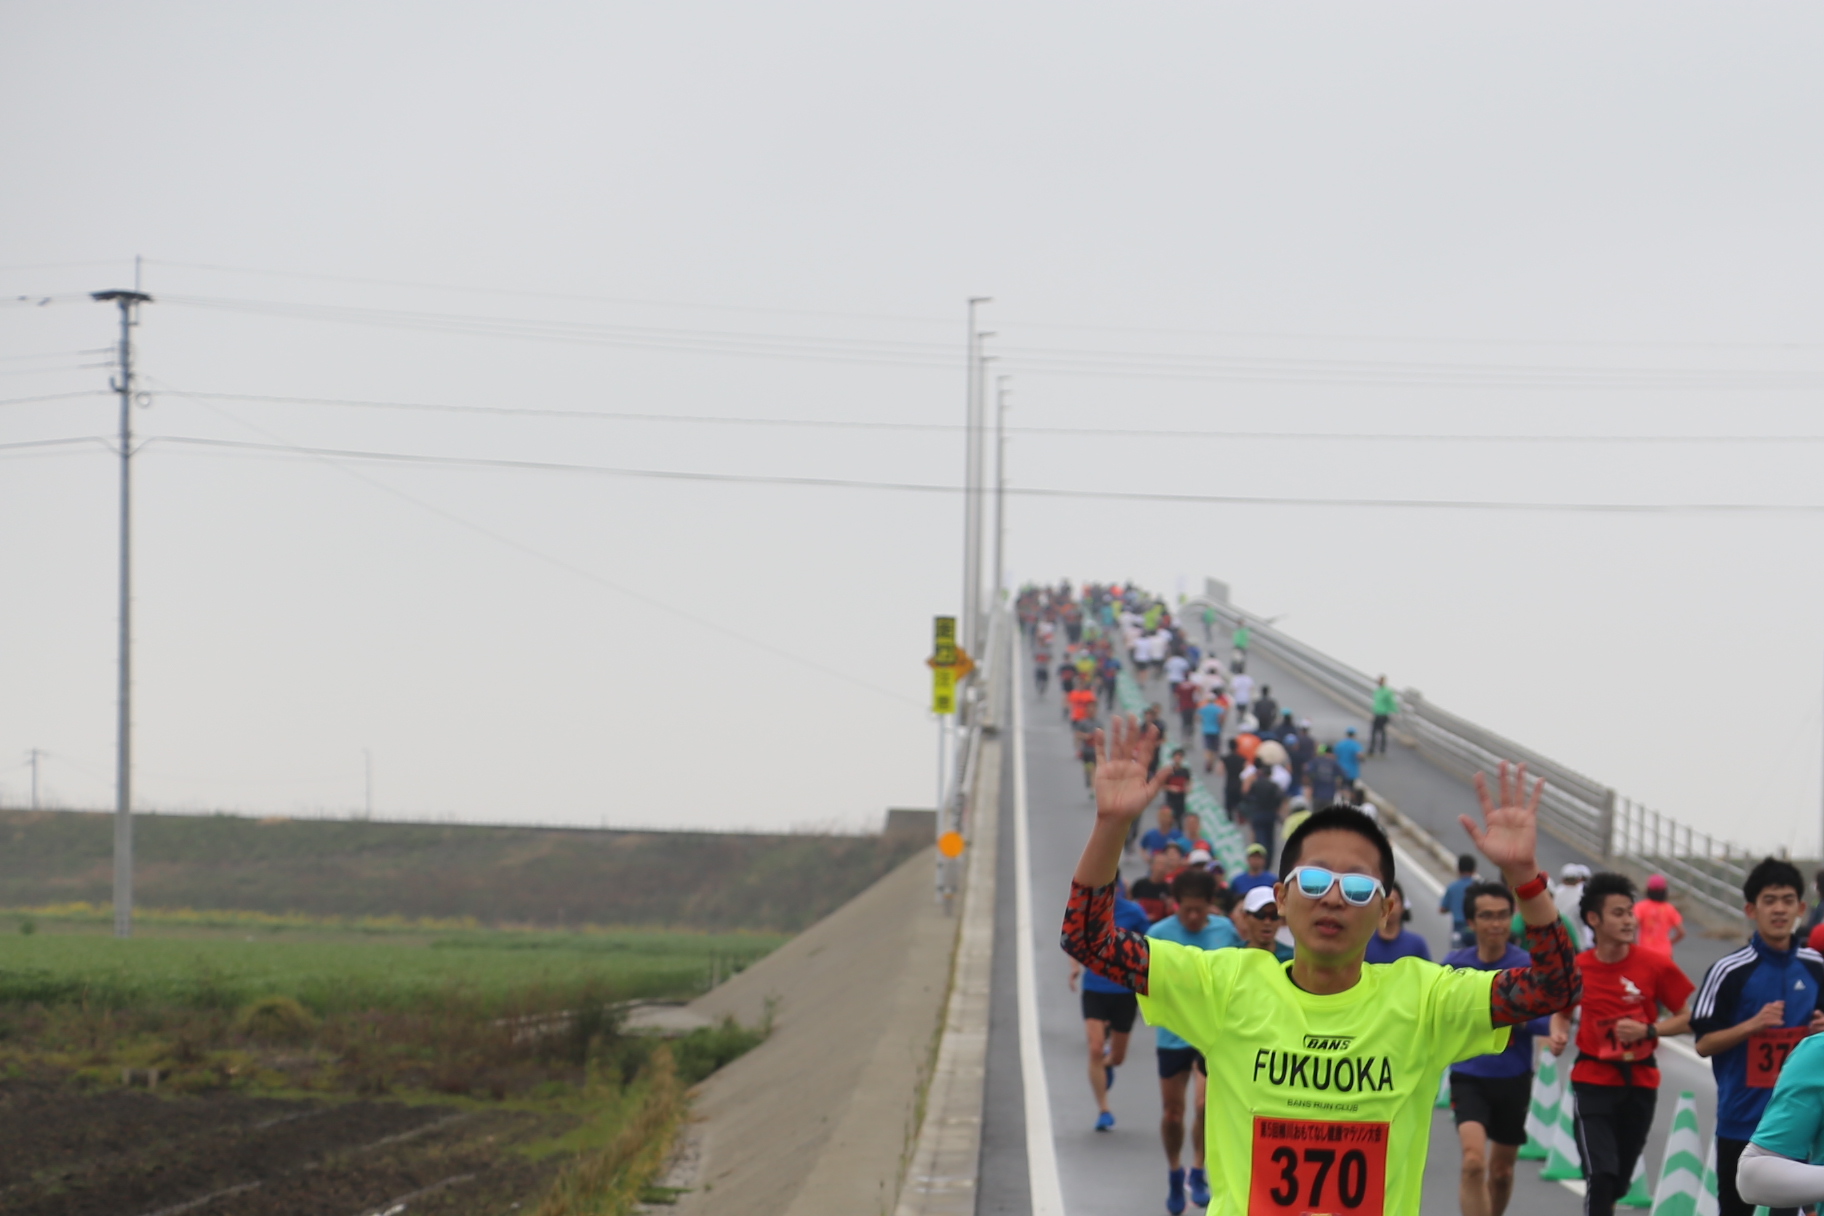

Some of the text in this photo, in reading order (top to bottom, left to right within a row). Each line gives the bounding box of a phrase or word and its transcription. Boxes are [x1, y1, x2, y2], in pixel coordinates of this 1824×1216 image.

[1253, 1049, 1394, 1092] FUKUOKA
[1287, 1099, 1359, 1112] BANS RUN CLUB
[1270, 1146, 1367, 1208] 370
